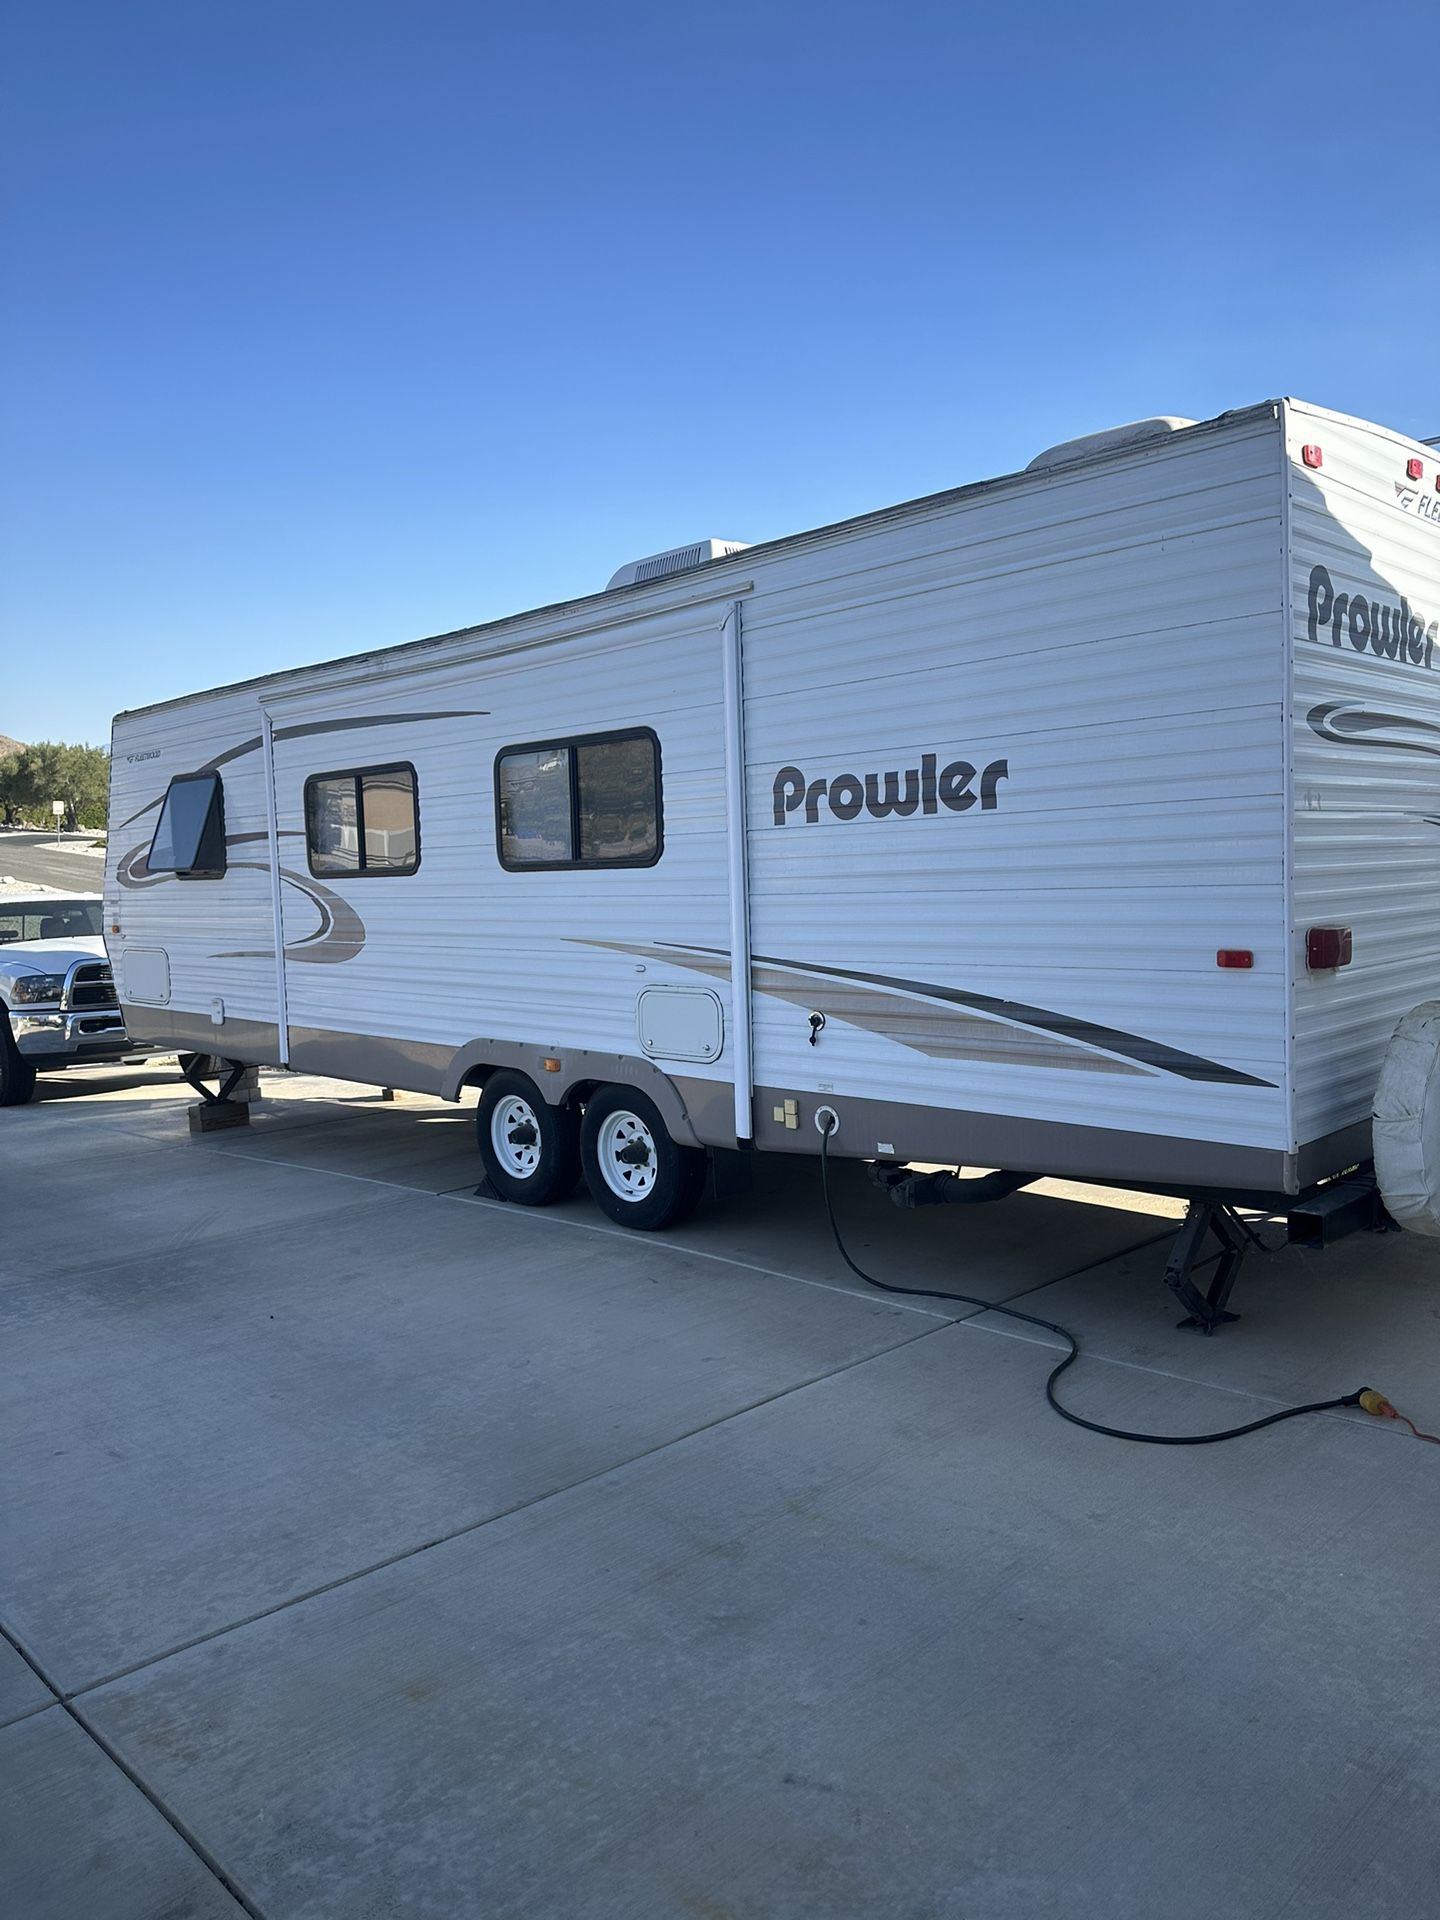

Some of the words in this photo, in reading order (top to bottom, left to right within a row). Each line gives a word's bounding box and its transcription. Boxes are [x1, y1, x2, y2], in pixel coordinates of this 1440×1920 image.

[1418, 494, 1440, 522] FLE
[1308, 565, 1439, 669] Prowler
[773, 753, 1008, 825] Prowler
